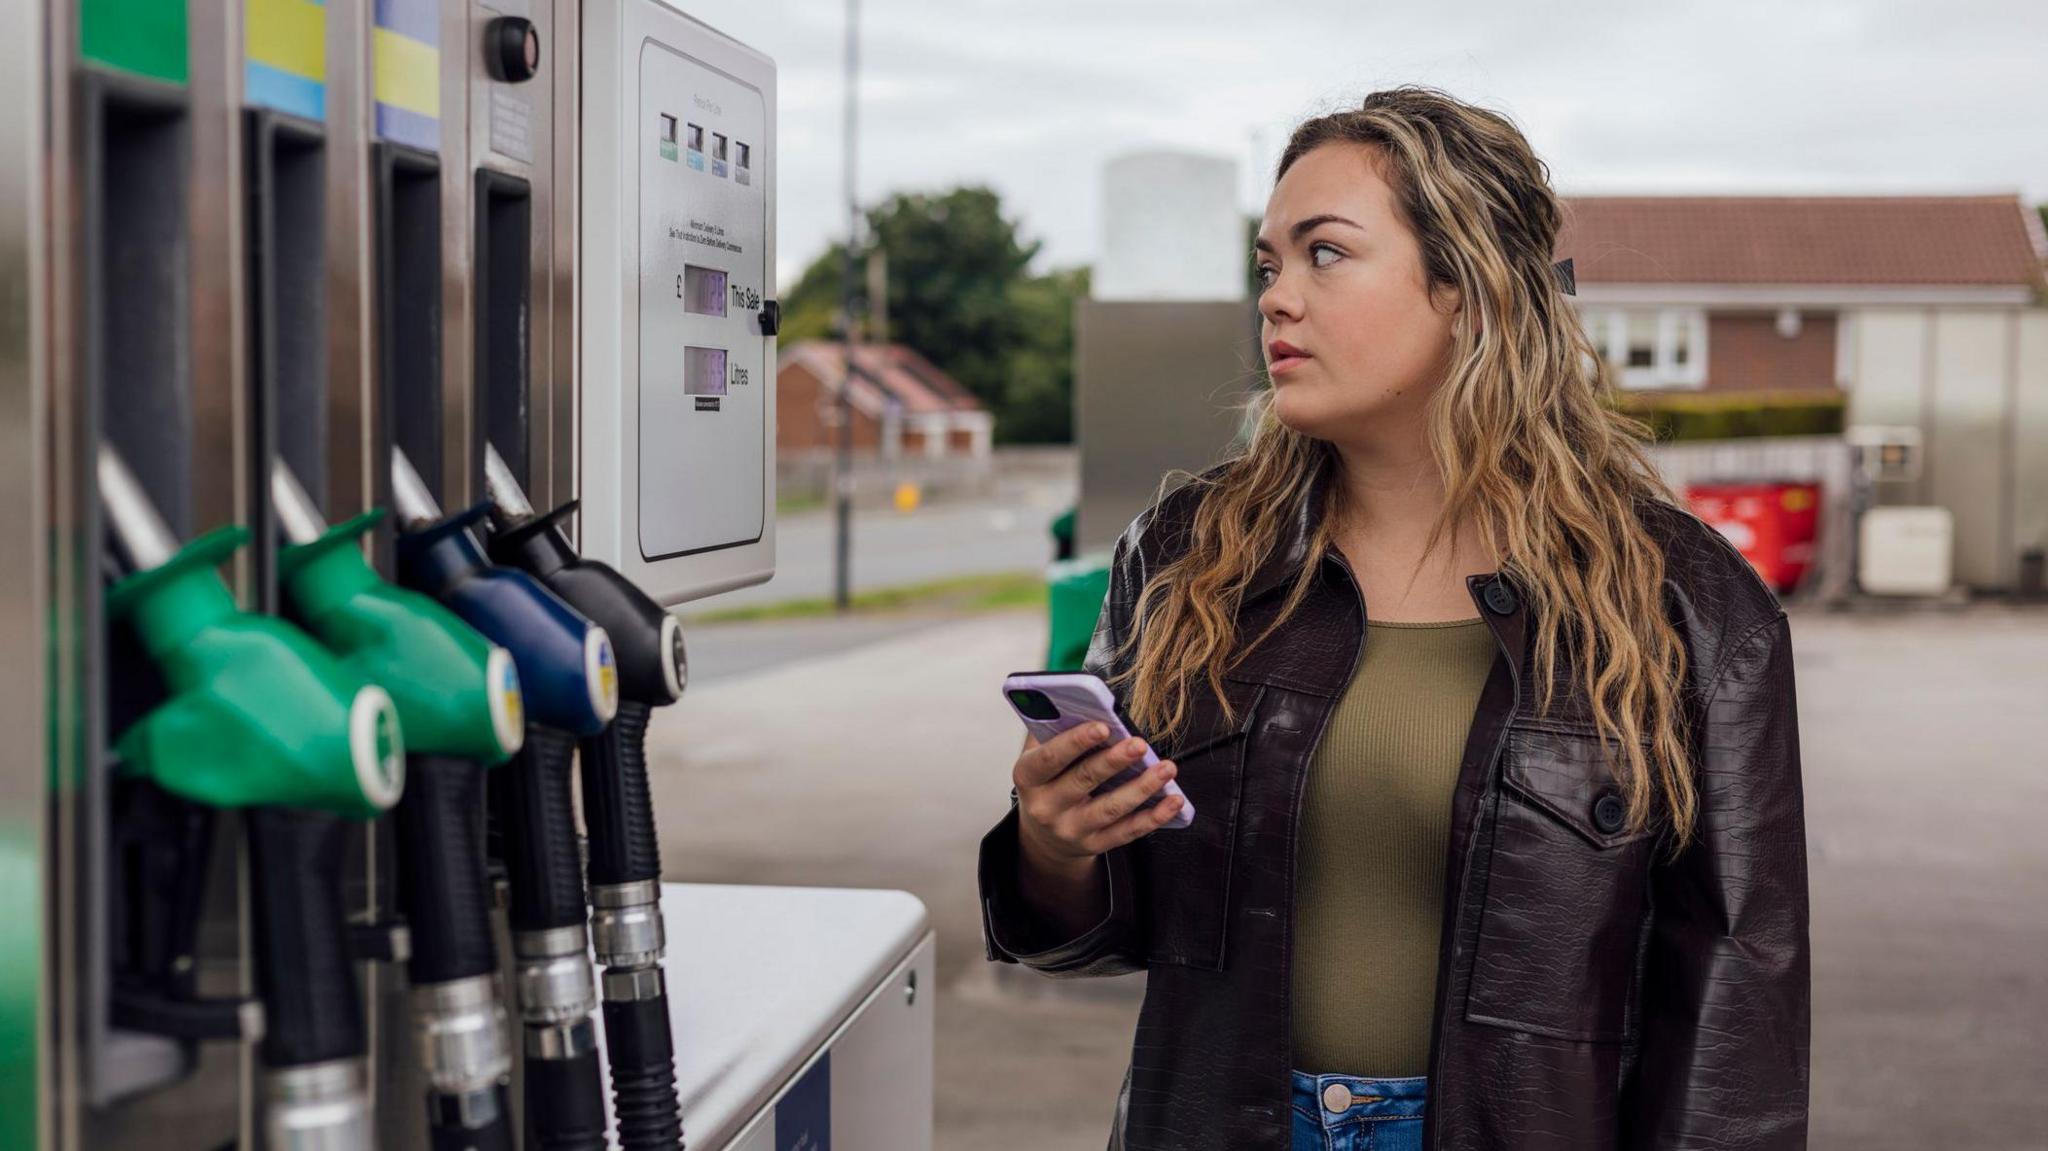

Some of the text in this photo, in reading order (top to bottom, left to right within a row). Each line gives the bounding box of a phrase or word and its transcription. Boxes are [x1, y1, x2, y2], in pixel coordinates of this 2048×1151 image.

[676, 274, 682, 299] £
[731, 284, 745, 309] This
[746, 287, 760, 310] Sale
